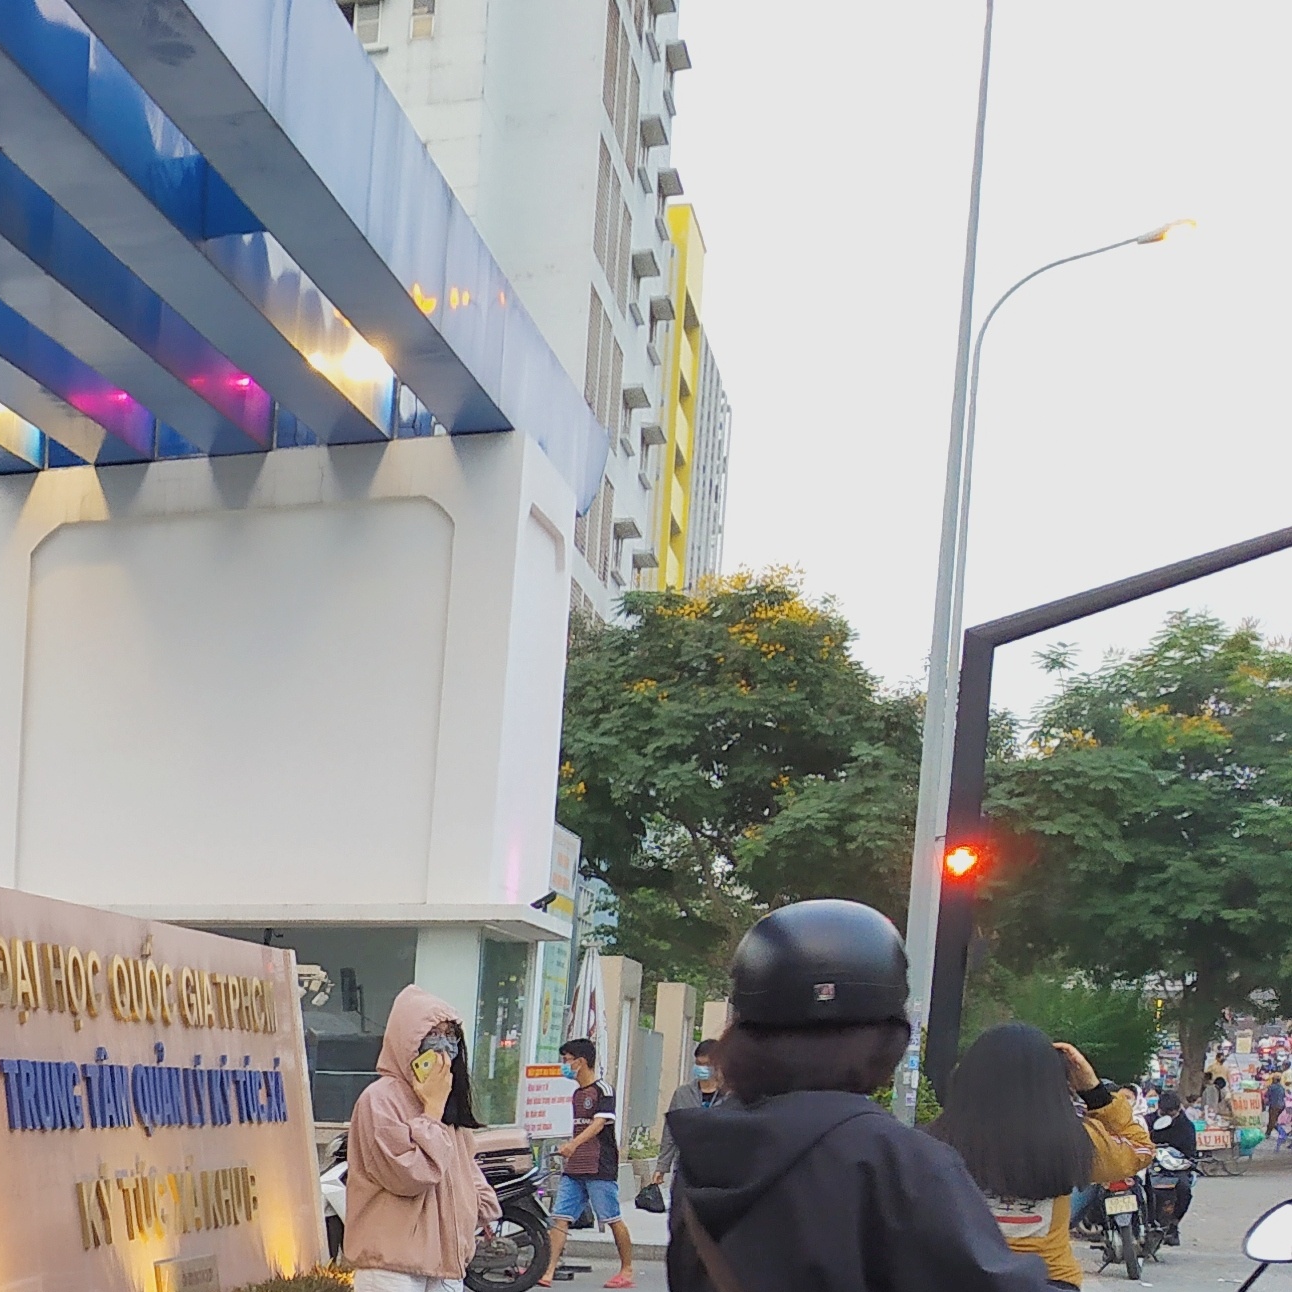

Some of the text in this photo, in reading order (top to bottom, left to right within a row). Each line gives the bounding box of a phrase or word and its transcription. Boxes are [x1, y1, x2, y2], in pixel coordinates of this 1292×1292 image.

[41, 942, 103, 1032] HỌC
[107, 933, 177, 1027] QUỐC
[179, 965, 216, 1029] GIA
[81, 1046, 133, 1130] TÂM
[131, 1041, 184, 1138] QUẢN
[183, 1054, 206, 1129] LÝ
[207, 1054, 232, 1128] KÝ
[232, 1055, 264, 1126] TÚC
[75, 1163, 113, 1252] KÝ
